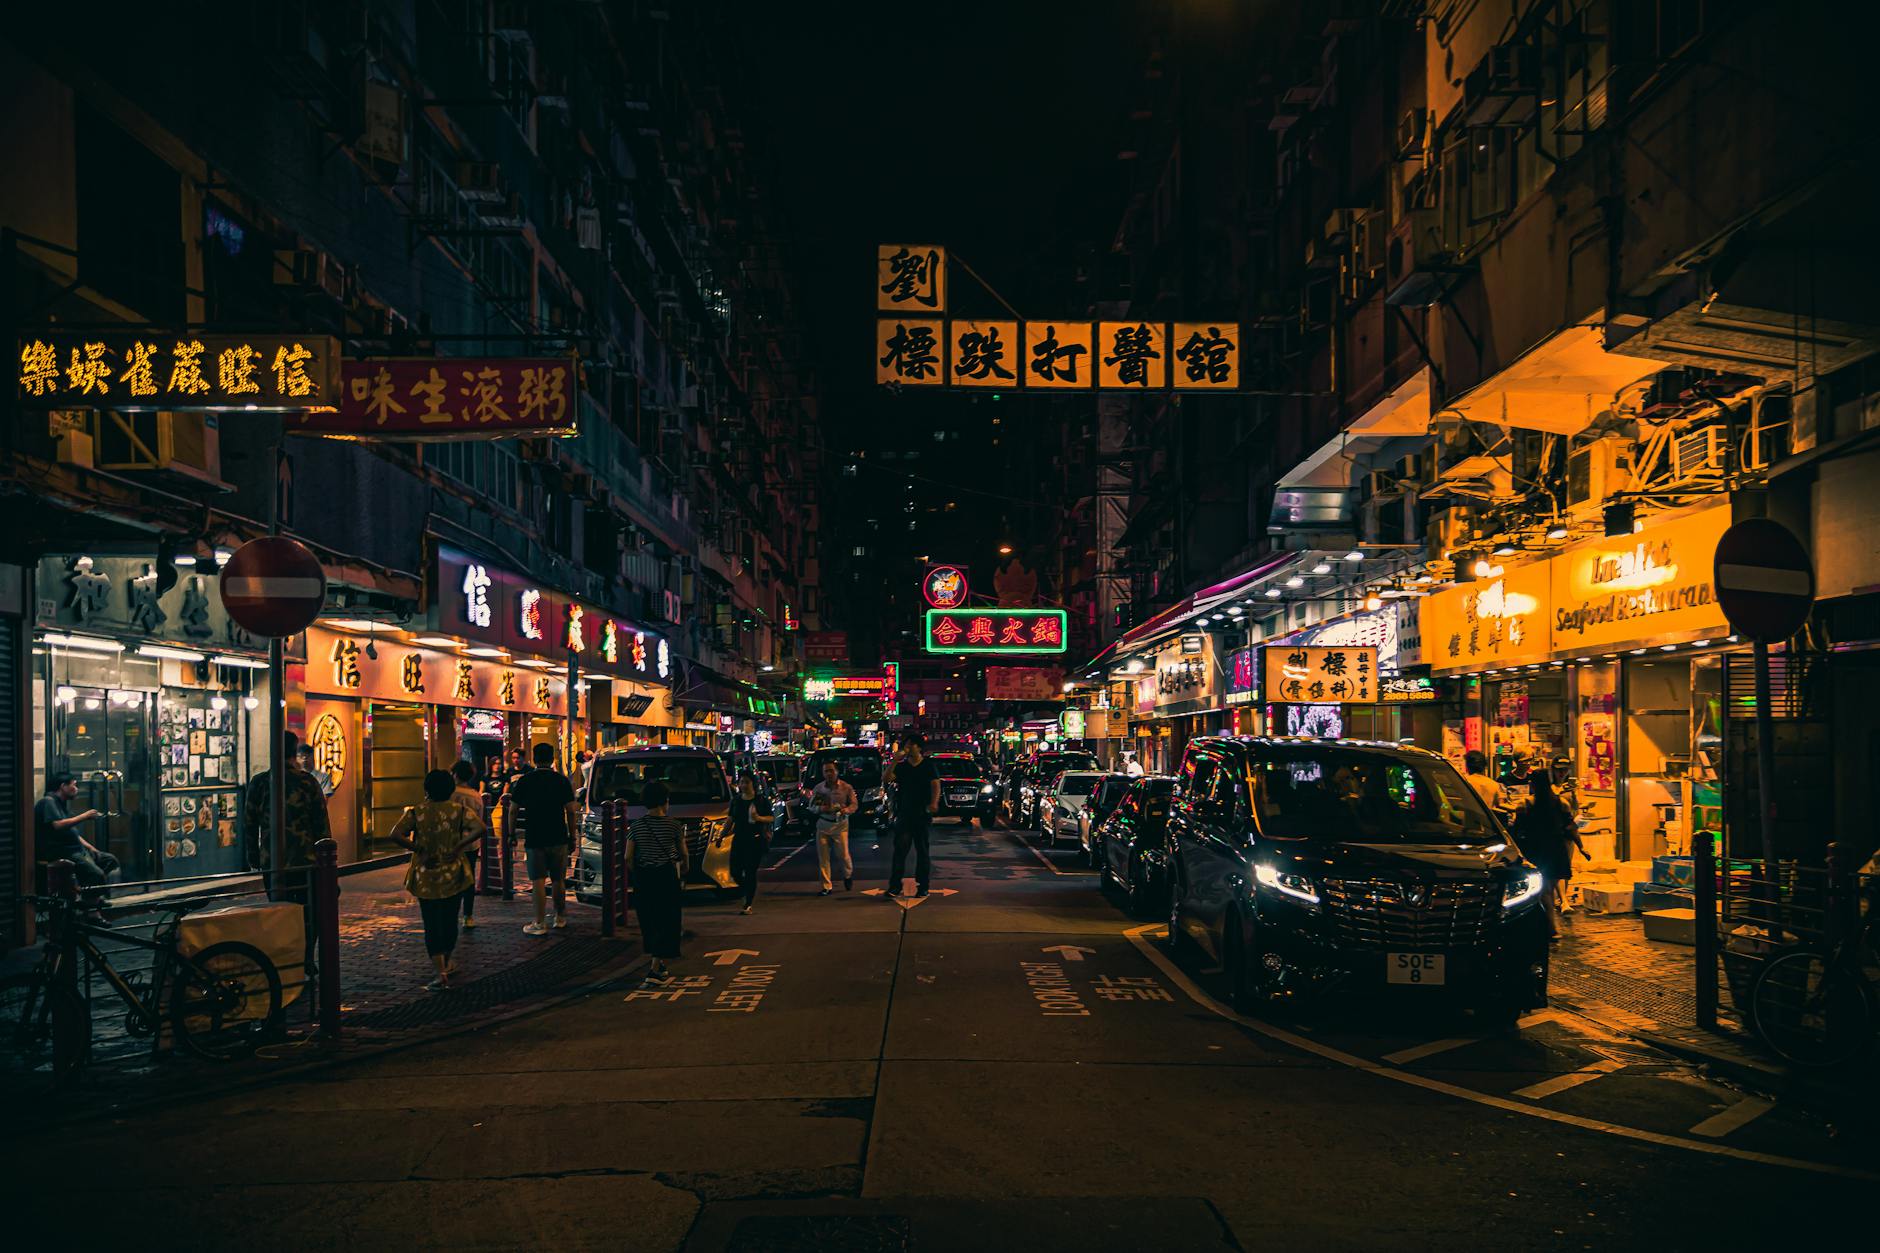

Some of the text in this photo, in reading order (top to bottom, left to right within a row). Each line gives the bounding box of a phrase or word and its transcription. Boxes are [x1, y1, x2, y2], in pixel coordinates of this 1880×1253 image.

[881, 248, 938, 308] 劉
[298, 366, 568, 426] 味生滾粥
[1555, 594, 1615, 635] Seafood
[1616, 582, 1719, 623] Restauran
[1019, 960, 1092, 1016] LOOK RIGHT
[1398, 954, 1435, 969] SOE
[1410, 969, 1421, 983] 8
[704, 964, 783, 1013] LOOK LEFT
